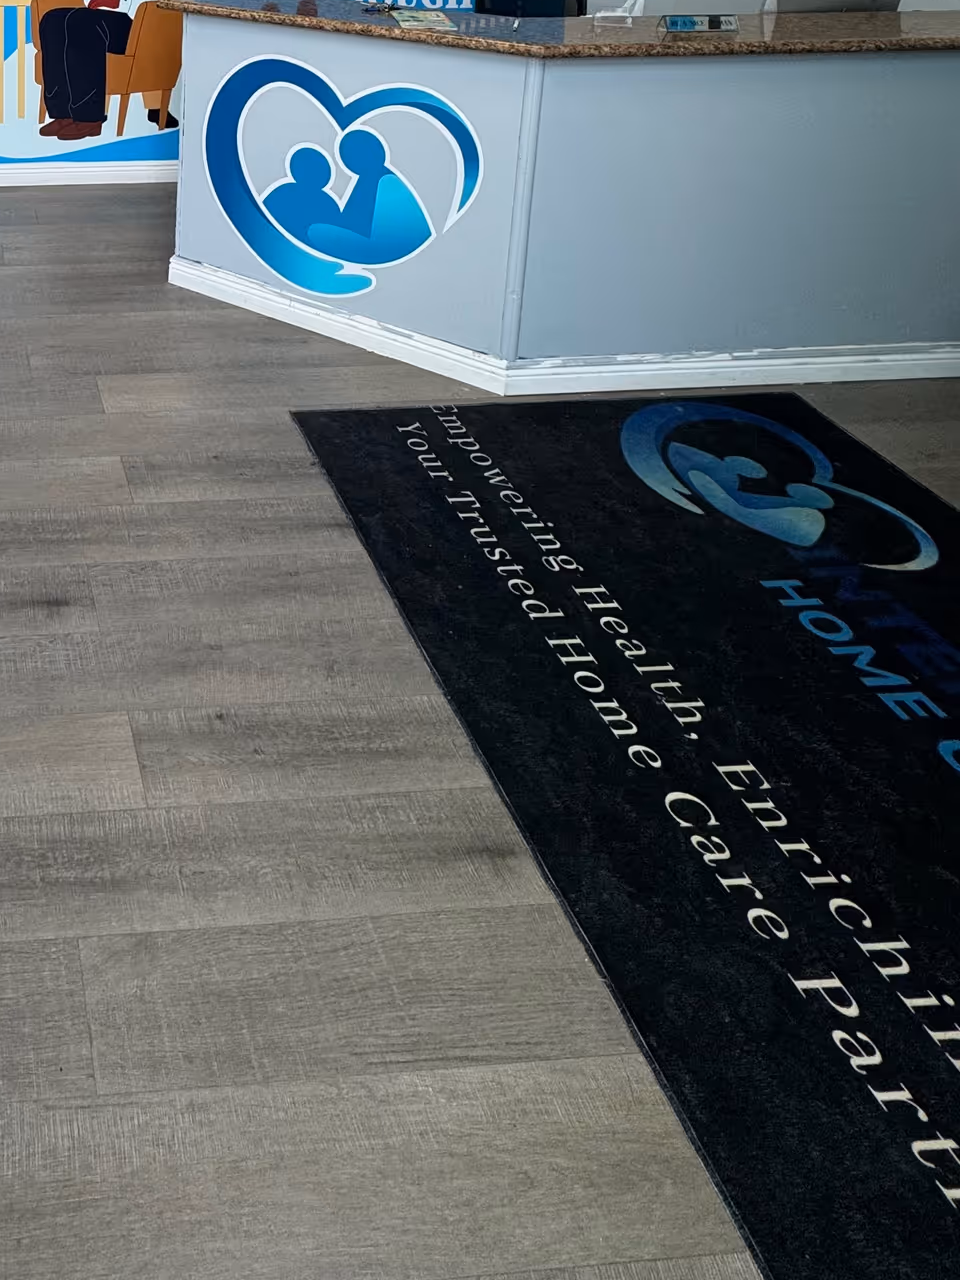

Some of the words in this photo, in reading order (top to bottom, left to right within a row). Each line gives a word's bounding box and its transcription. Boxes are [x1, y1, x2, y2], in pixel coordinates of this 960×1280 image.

[396, 422, 454, 482] Your
[445, 490, 565, 621] Trusted
[545, 635, 662, 769] Home
[664, 791, 790, 940] Care
[429, 404, 584, 572] Empowering
[572, 584, 706, 740] Health,
[759, 578, 951, 721] HOME
